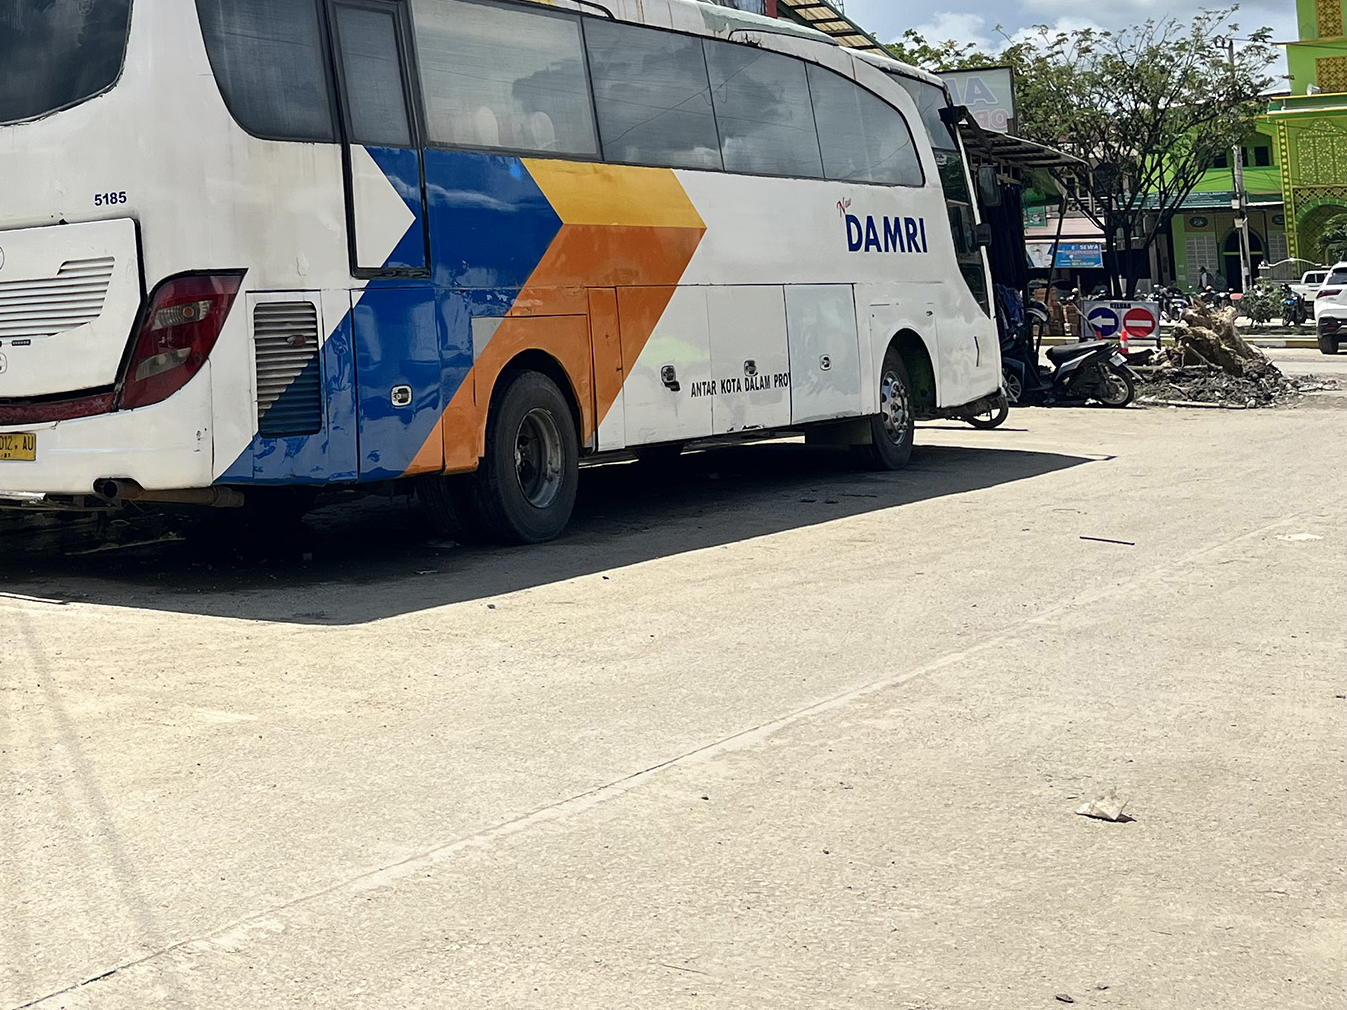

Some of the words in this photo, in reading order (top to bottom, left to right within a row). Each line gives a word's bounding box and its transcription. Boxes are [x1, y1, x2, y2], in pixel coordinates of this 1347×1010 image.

[94, 191, 127, 206] 5185
[844, 214, 929, 254] DAMRI
[691, 381, 717, 398] ANTAR
[721, 378, 742, 394] KOTA
[745, 375, 771, 392] DALAM
[774, 372, 790, 388] PRO
[22, 435, 34, 450] AU
